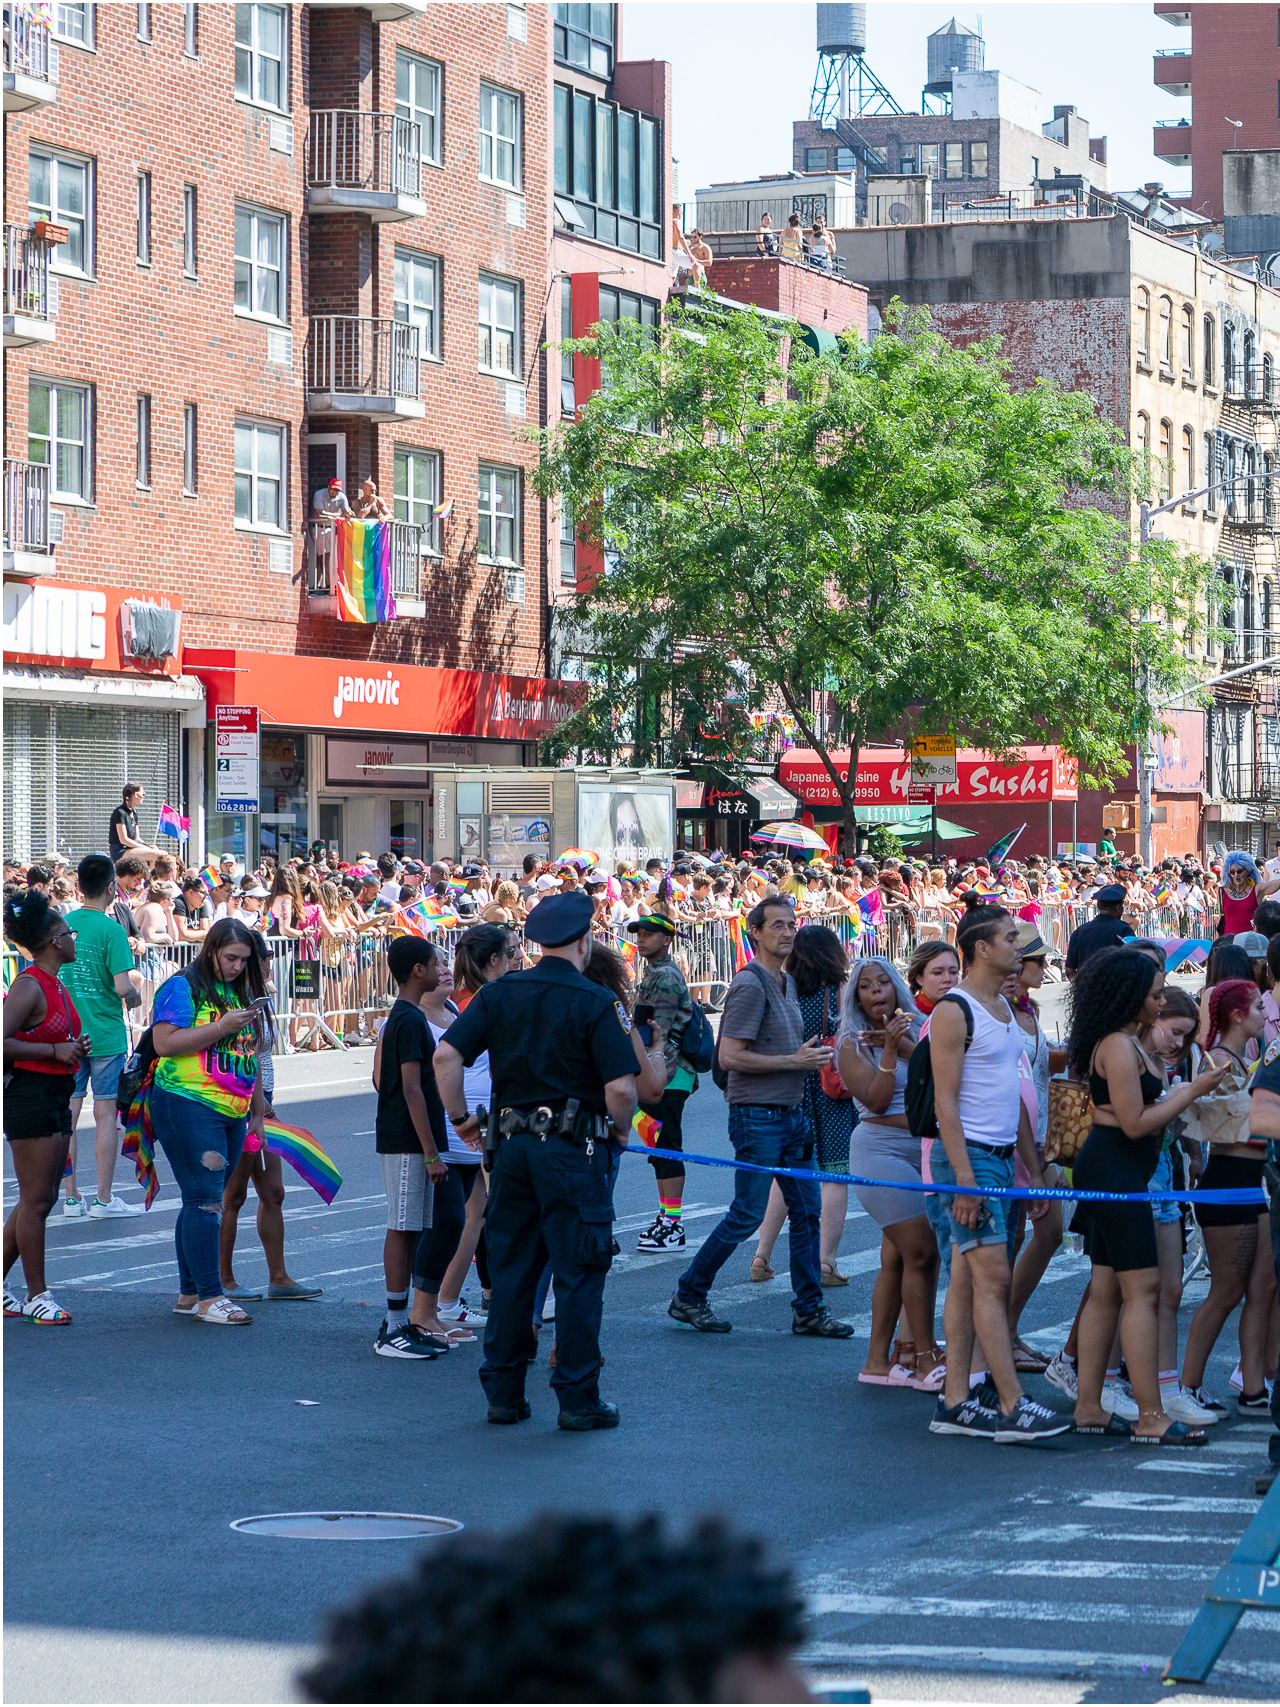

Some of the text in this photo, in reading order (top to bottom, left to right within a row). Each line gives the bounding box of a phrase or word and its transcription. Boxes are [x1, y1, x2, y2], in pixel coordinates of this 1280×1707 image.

[504, 692, 545, 726] Benjamin
[219, 760, 228, 771] 2
[786, 770, 880, 785] Japanes Csine
[969, 765, 1049, 797] Sushi
[806, 787, 830, 802] (212)
[438, 788, 447, 840] Newsstand
[717, 800, 748, 814] はな
[866, 807, 911, 821] RESTIVO
[638, 847, 662, 861] BRAVE
